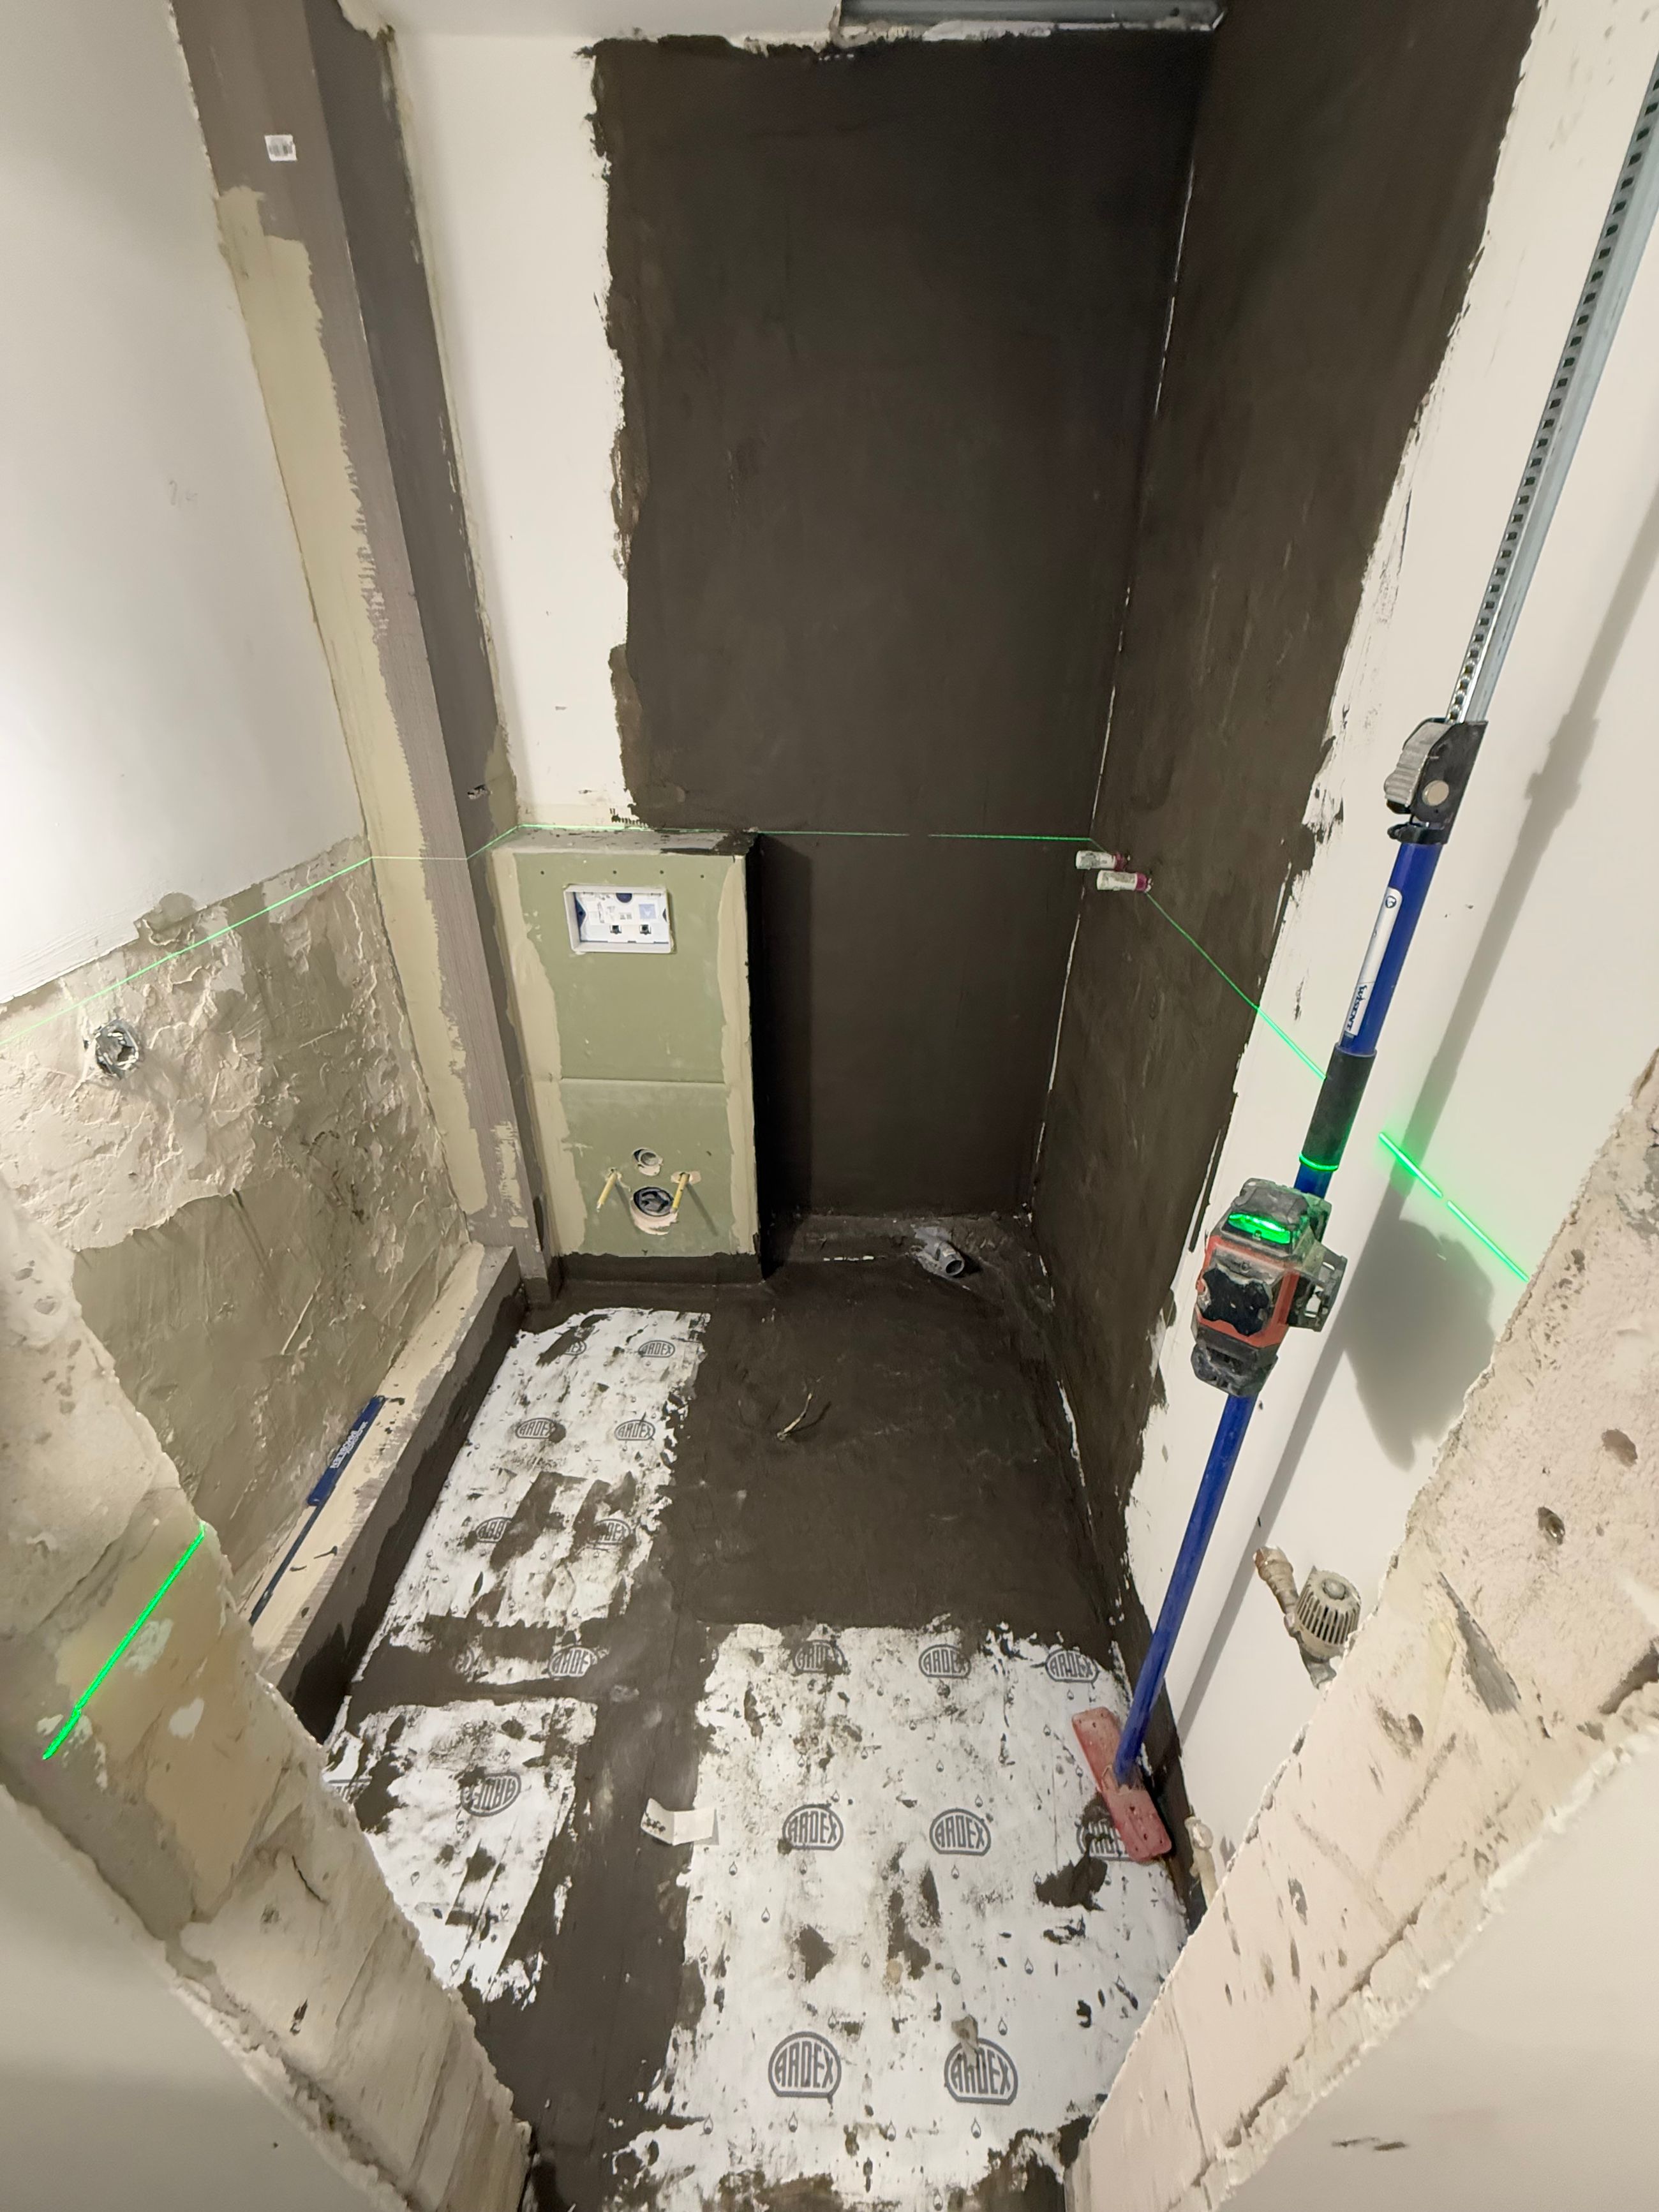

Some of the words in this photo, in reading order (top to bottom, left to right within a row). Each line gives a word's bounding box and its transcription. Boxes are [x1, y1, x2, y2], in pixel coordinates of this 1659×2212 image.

[1346, 984, 1367, 1031] WISENT
[618, 1423, 651, 1438] ARDEX
[1050, 1652, 1093, 1678] ARDEX
[787, 1811, 837, 1844] ARDEX
[935, 1815, 985, 1849] ARDEX
[775, 2041, 833, 2088] ARDEX
[950, 2045, 1011, 2095] ARDEX
